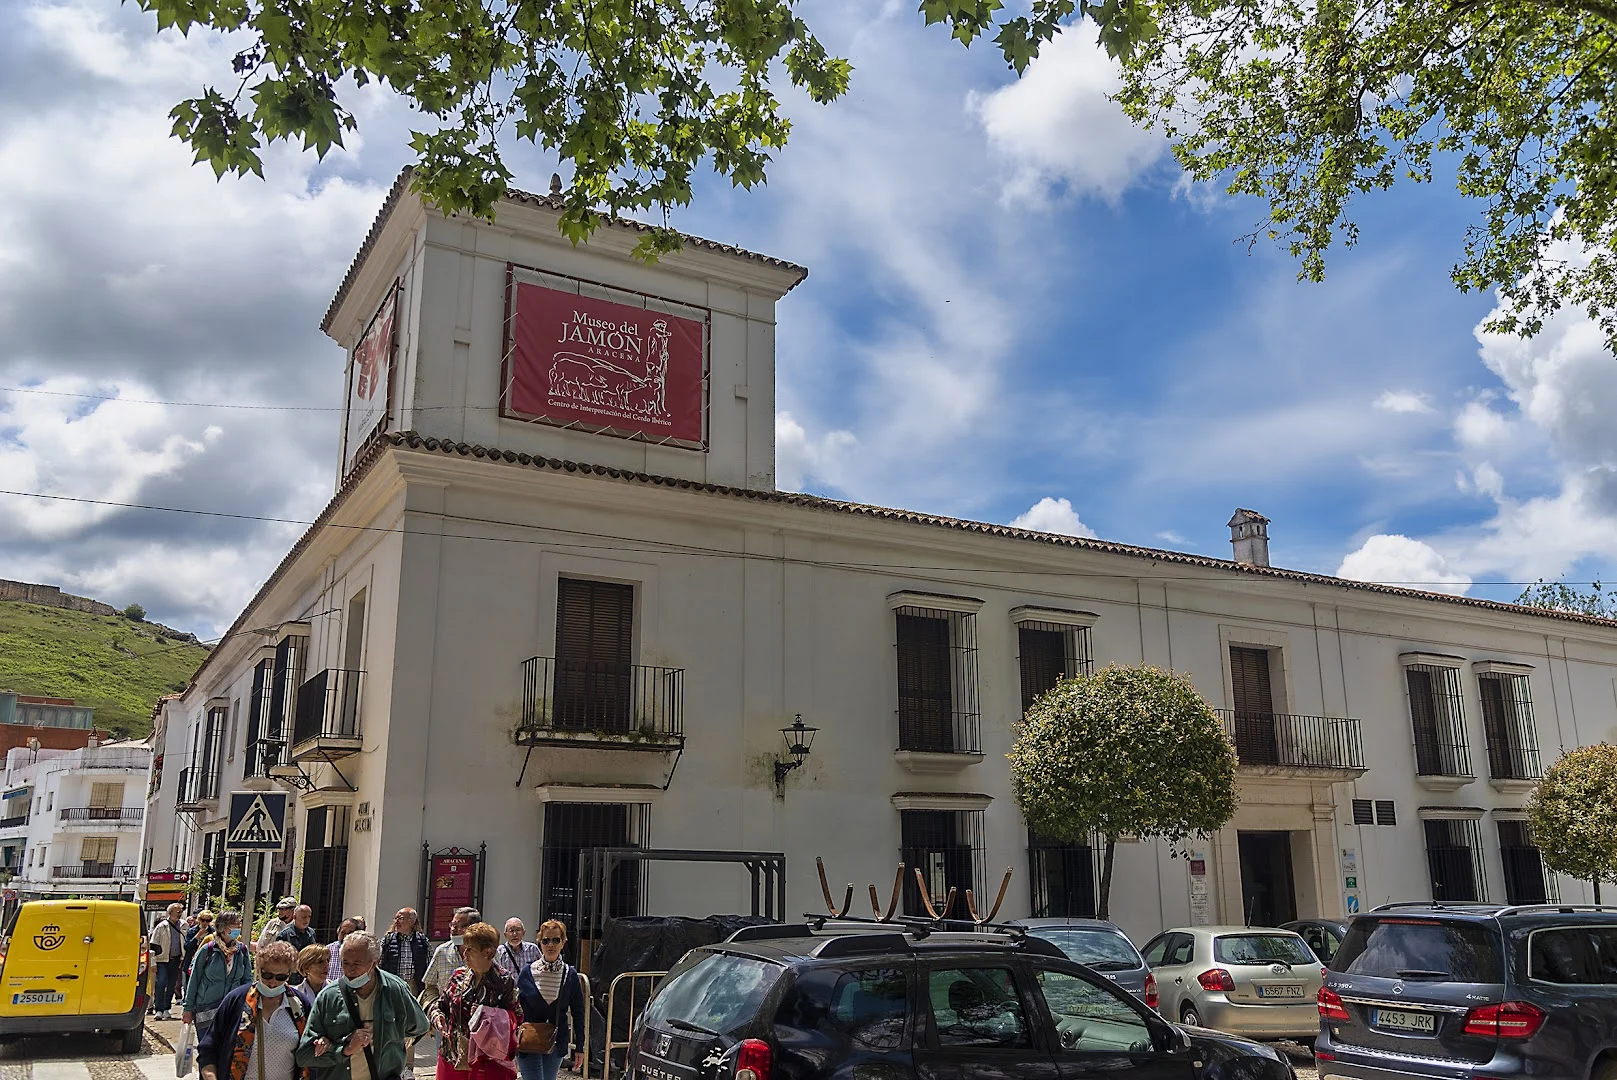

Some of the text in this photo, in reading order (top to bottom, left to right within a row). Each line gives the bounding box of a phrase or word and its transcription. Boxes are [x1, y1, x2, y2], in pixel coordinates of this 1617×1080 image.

[573, 310, 638, 336] Museo del
[558, 322, 643, 355] JAMÓN
[588, 347, 641, 363] ARACENA
[547, 398, 672, 426] Centro de Interpretación del Cerdo Ibérico
[20, 994, 65, 1004] 2550 LLH
[1264, 986, 1300, 996] 6567 FNZ
[1378, 1010, 1433, 1029] 4453 JRK
